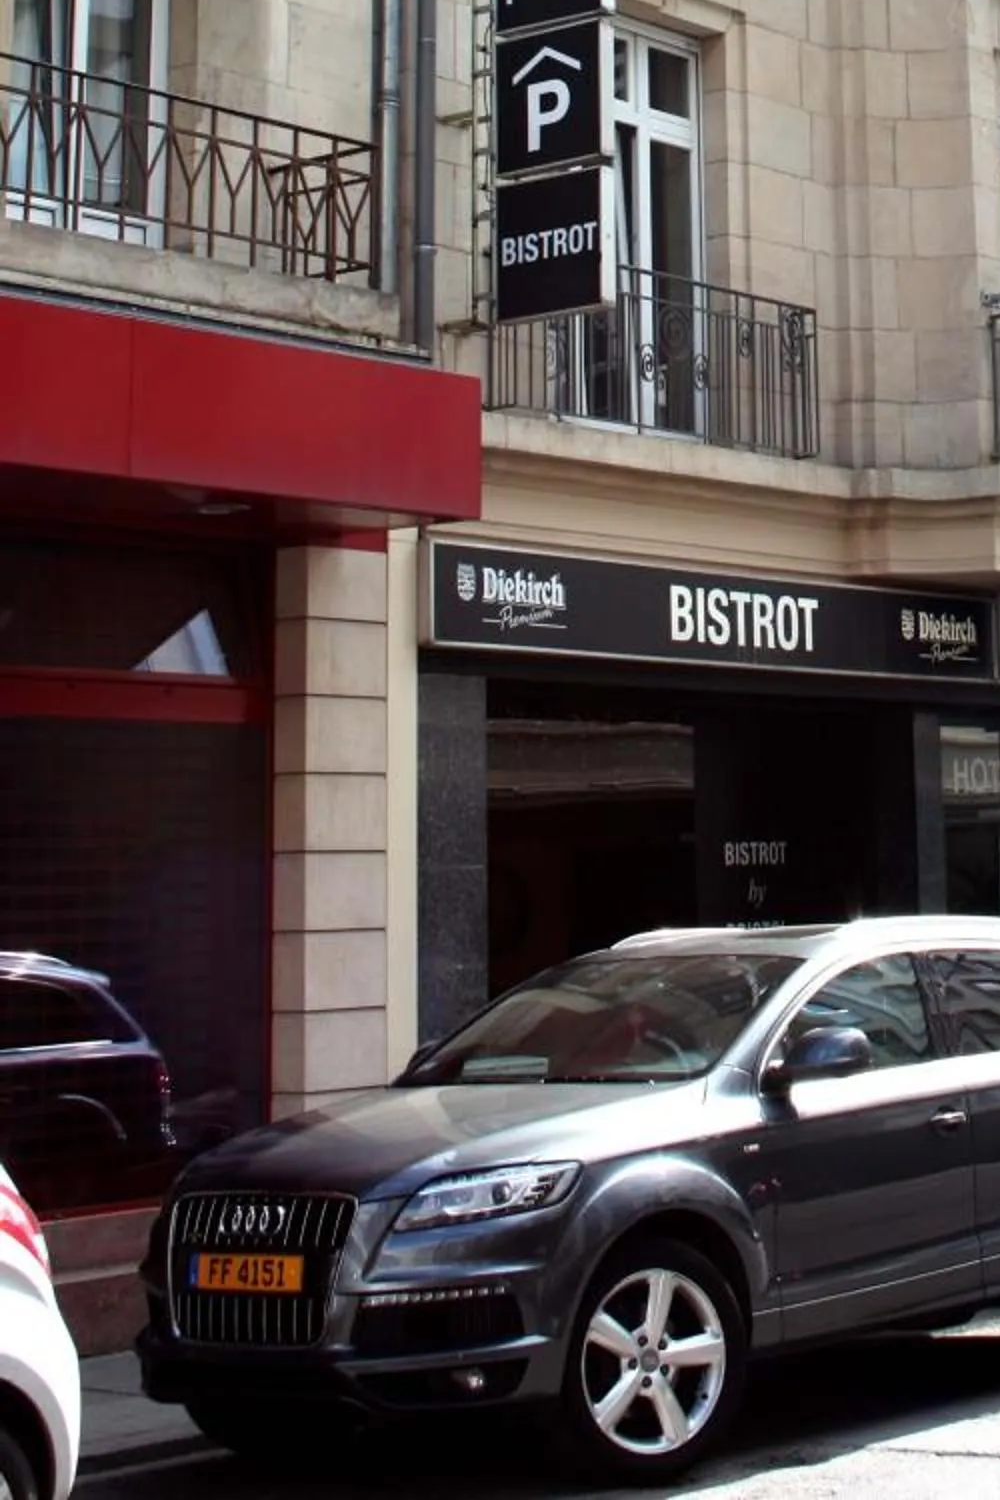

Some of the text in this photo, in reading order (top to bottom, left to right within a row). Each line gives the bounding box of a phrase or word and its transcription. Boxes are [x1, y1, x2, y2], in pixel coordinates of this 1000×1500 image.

[526, 78, 571, 153] P
[501, 222, 597, 267] BISTROT
[482, 566, 566, 607] Diekirch
[670, 584, 818, 652] BISTROT
[918, 611, 977, 644] Diekirch
[724, 841, 787, 867] BISTROT
[747, 878, 767, 909] by
[208, 1257, 286, 1287] FF 4151
